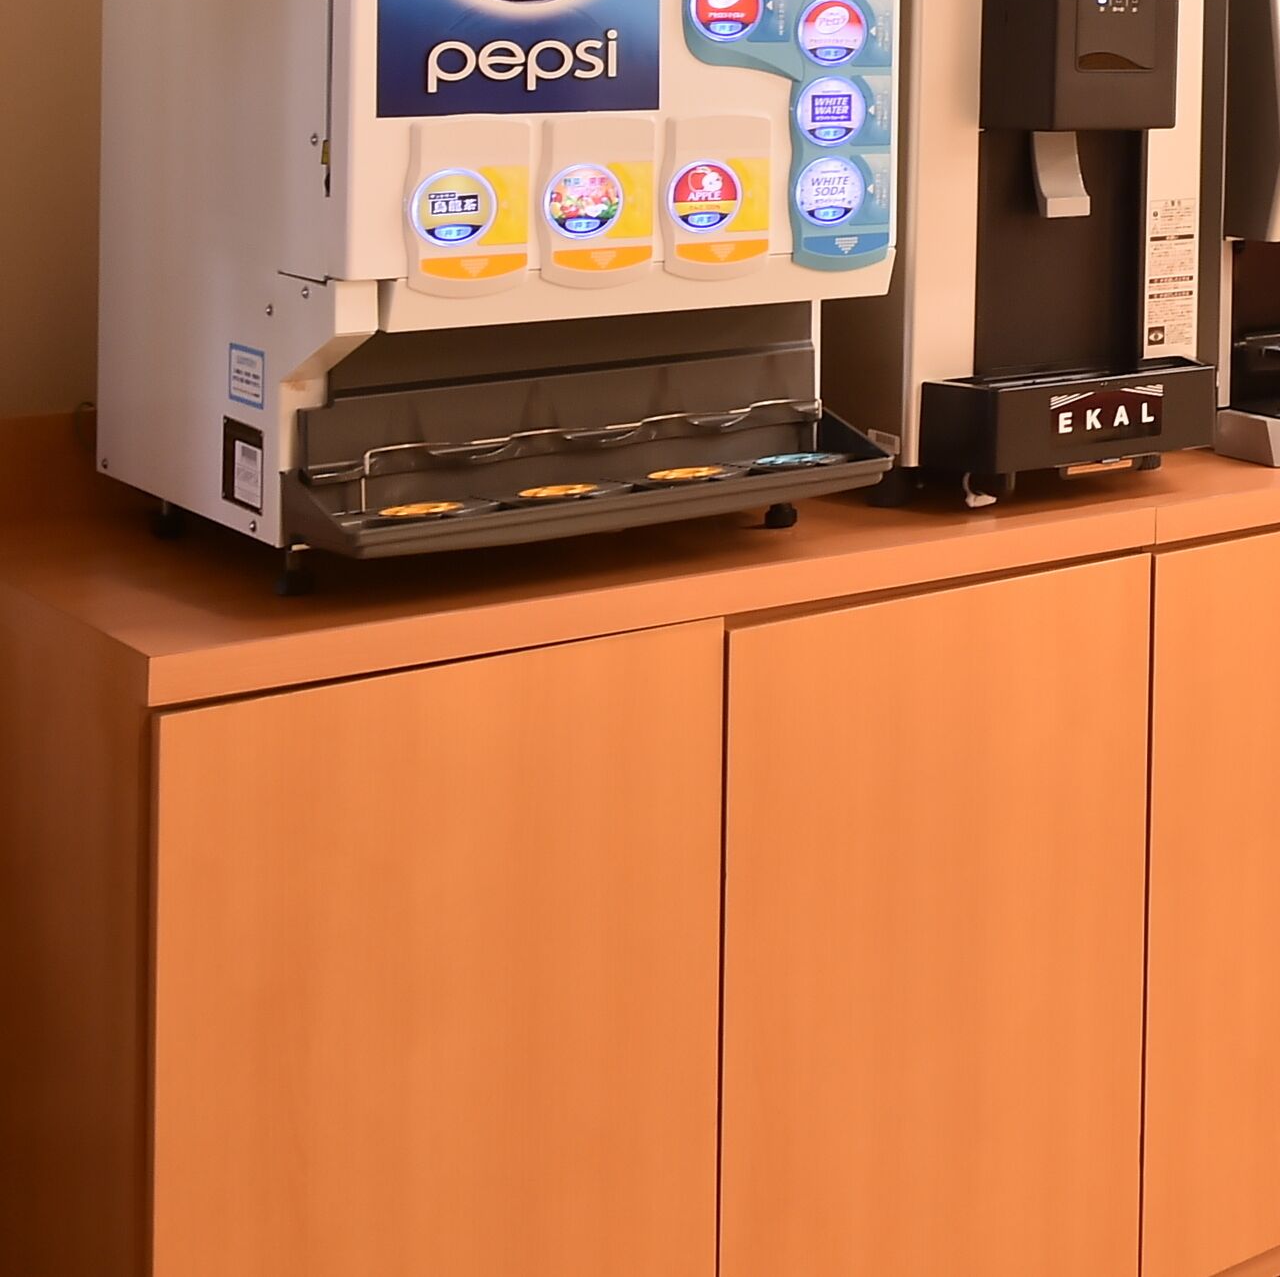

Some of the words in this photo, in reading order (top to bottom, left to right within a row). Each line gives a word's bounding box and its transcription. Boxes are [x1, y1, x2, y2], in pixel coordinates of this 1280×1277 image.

[426, 29, 619, 94] pepsi
[814, 96, 849, 106] WHITE
[815, 105, 849, 115] WATER
[811, 176, 849, 187] WHITE
[687, 190, 721, 201] APPLE
[814, 186, 846, 196] SODA
[432, 197, 478, 214] 烏龍茶
[1058, 401, 1155, 434] EKAL
